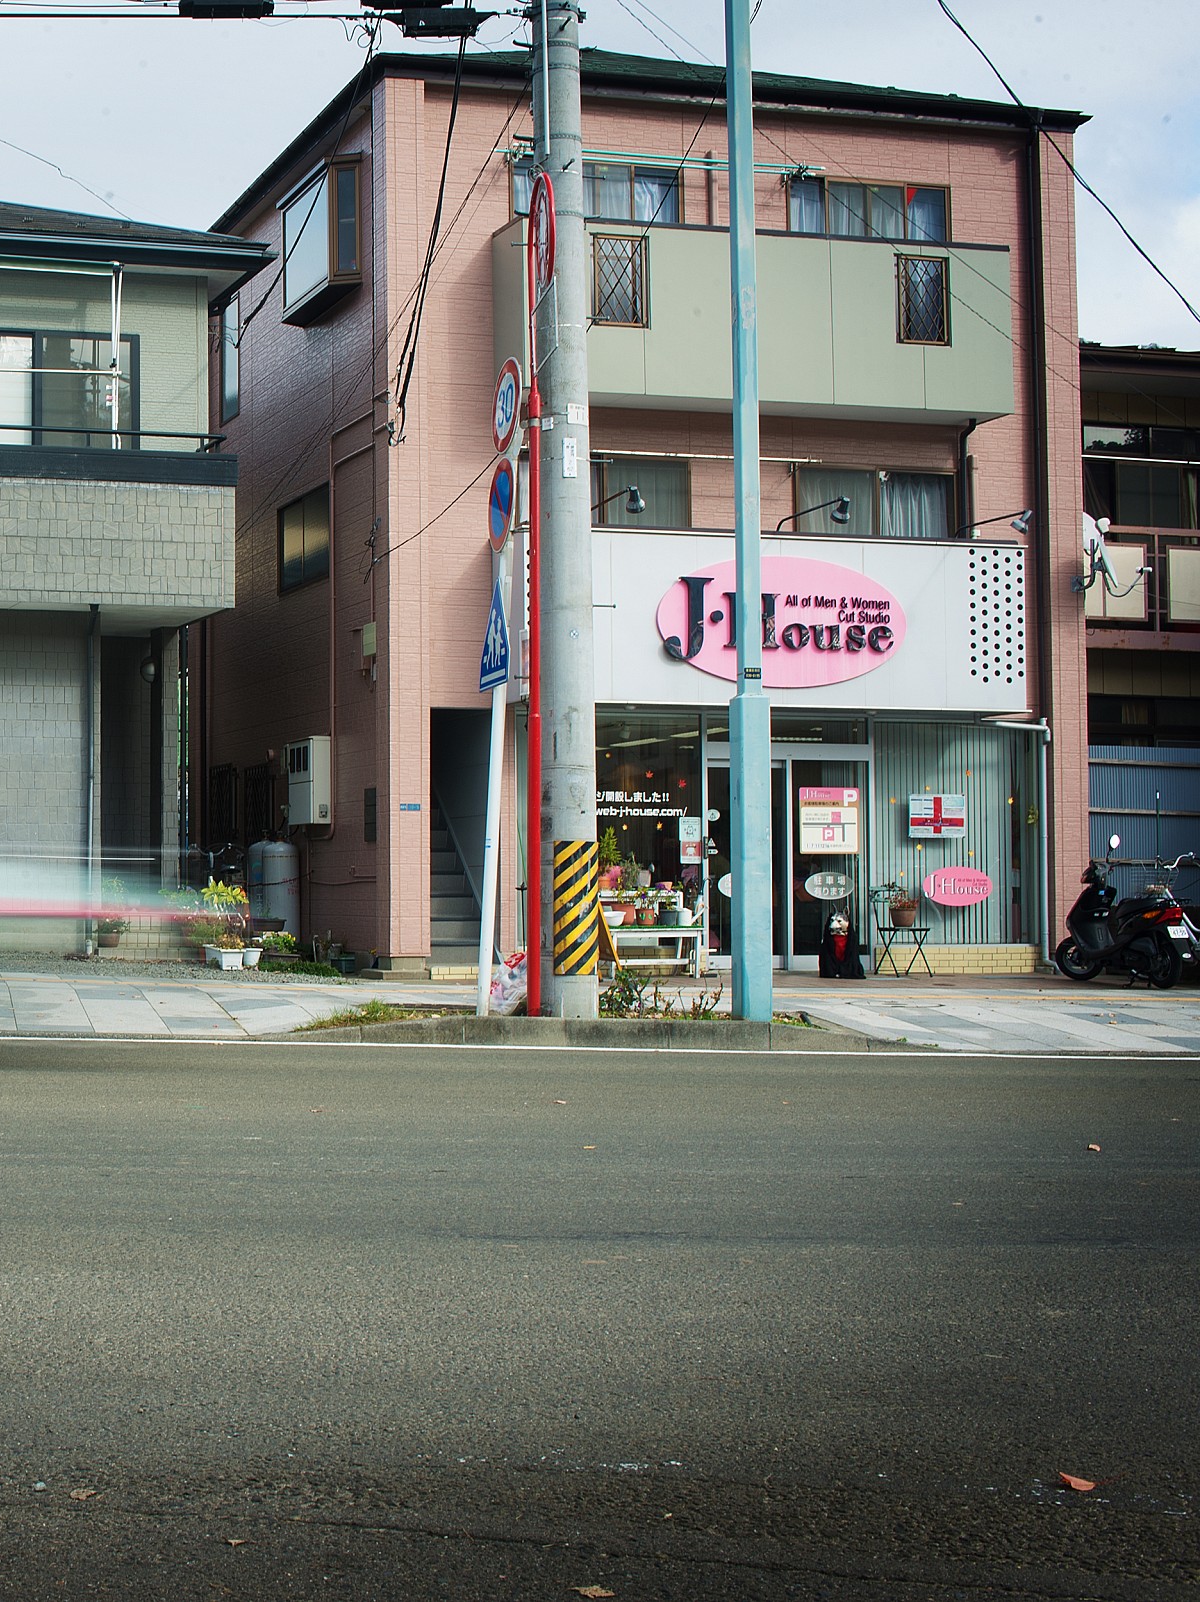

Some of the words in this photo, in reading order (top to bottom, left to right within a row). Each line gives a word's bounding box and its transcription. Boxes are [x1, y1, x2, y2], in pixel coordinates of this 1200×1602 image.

[498, 383, 514, 428] 30
[785, 594, 798, 607] All
[801, 595, 812, 607] of
[815, 595, 837, 608] Men
[840, 597, 848, 609] &
[851, 597, 890, 610] Women
[838, 609, 855, 623] Cut
[859, 611, 891, 624] Studio
[843, 790, 858, 807] P
[824, 829, 833, 840] P
[813, 886, 846, 896] 有ります
